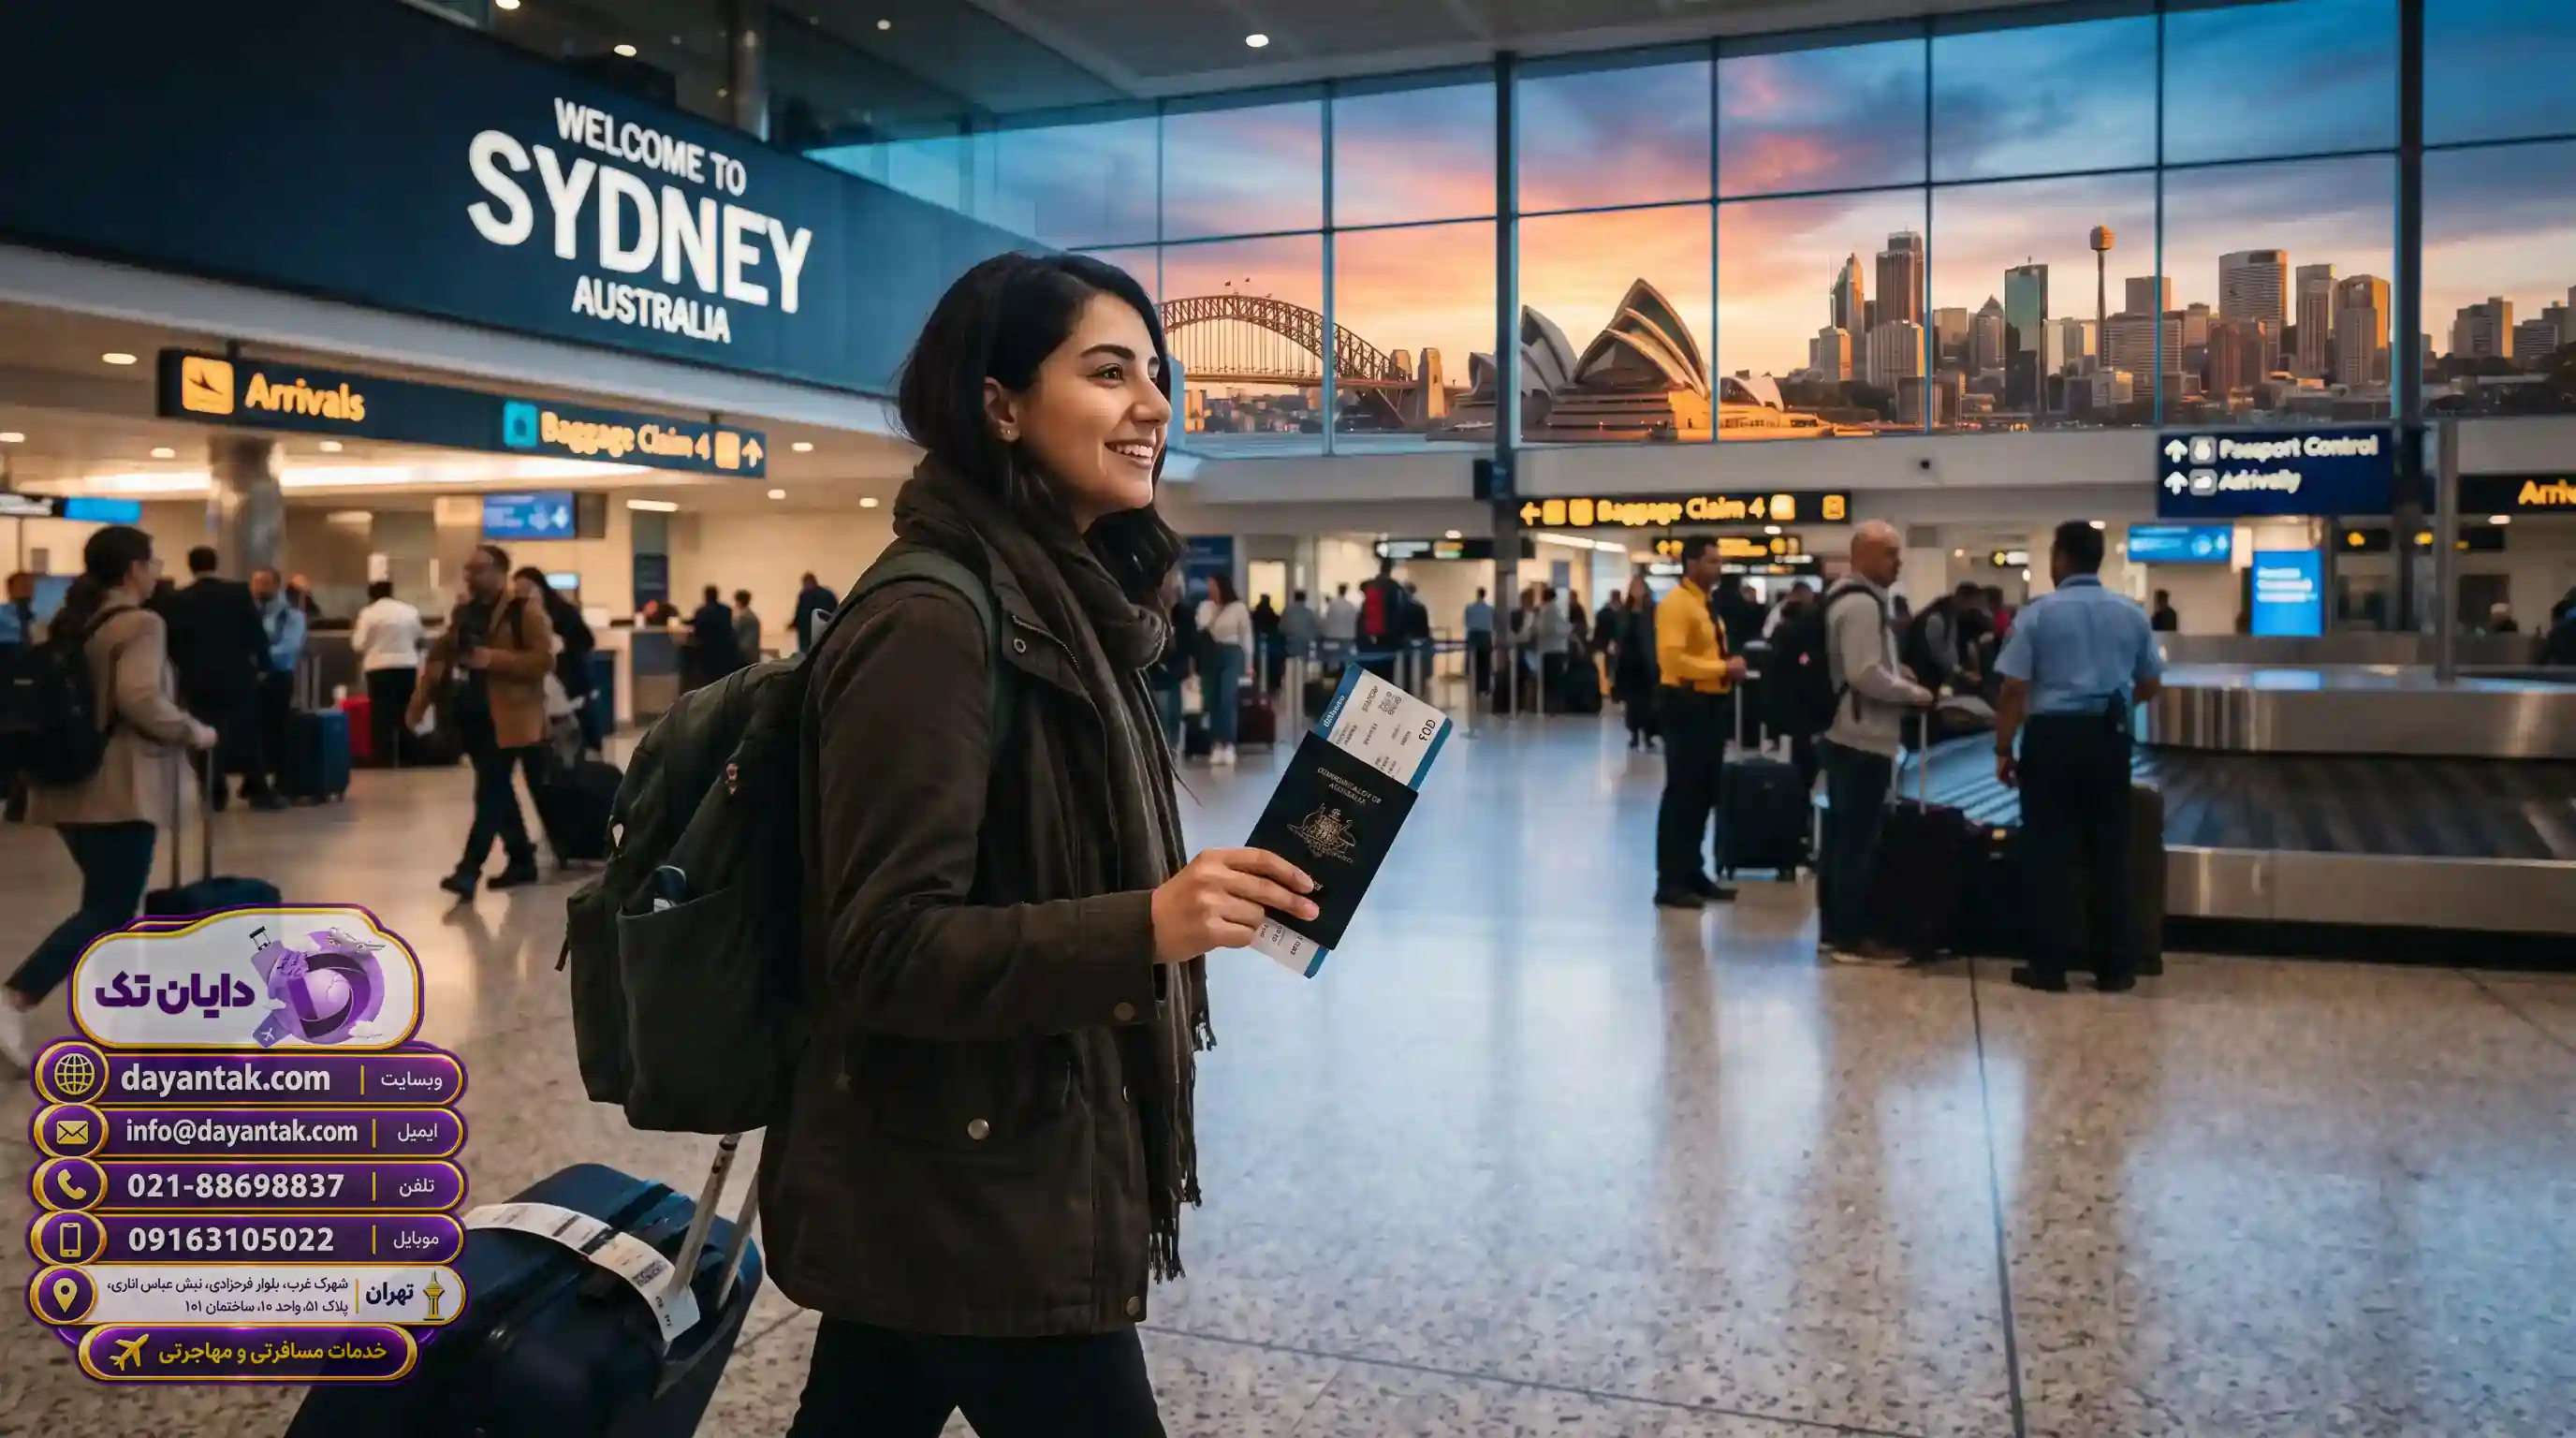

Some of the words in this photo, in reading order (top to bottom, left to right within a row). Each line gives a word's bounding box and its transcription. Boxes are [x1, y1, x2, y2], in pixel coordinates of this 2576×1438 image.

[554, 96, 705, 184] WELCOME
[710, 152, 747, 198] TO
[467, 129, 813, 315] SYDNEY
[571, 275, 731, 345] AUSTRALIA
[243, 372, 366, 422] Arrivals
[695, 433, 710, 461] 4
[1686, 496, 1746, 521] Claim
[1749, 496, 1765, 520] 4
